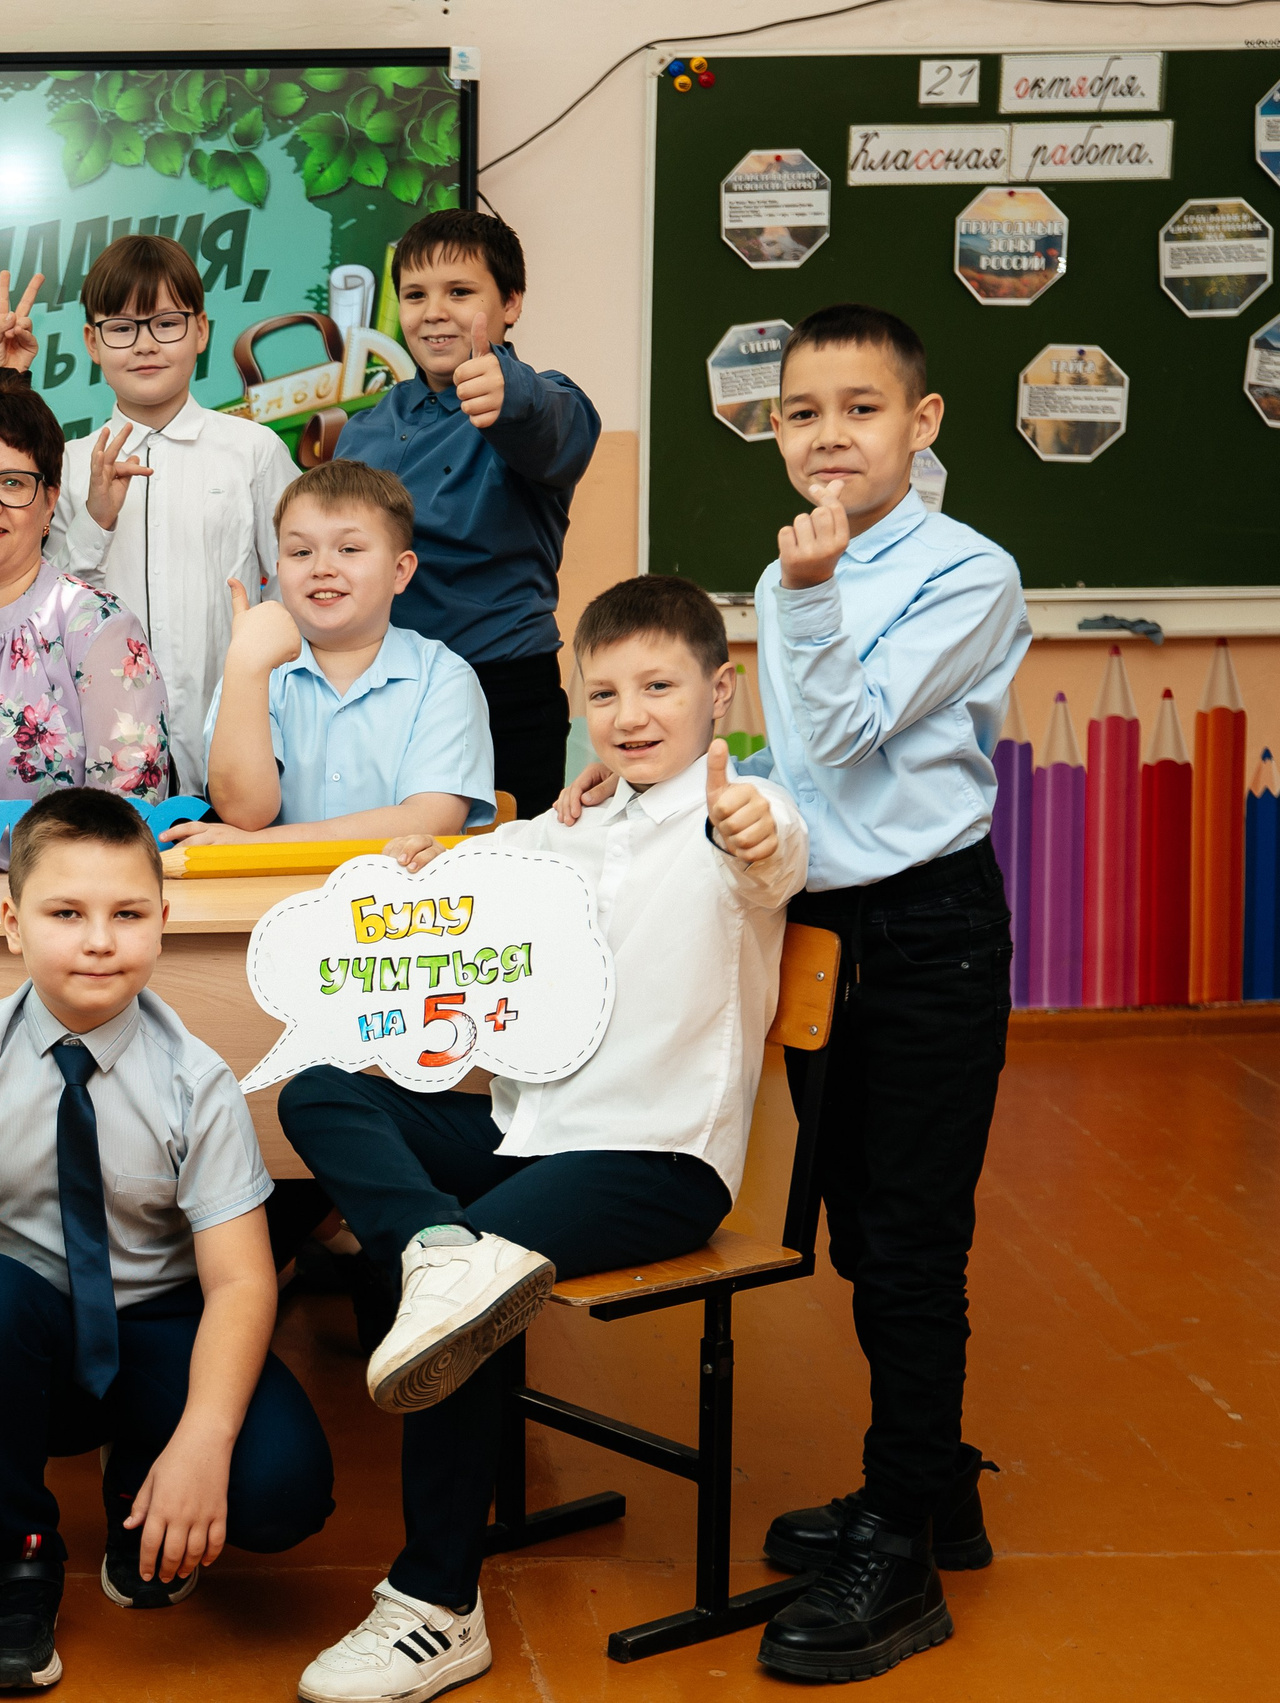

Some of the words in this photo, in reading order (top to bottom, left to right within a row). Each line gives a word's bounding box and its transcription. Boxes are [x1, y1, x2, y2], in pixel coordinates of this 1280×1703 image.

[925, 64, 978, 97] 21
[850, 131, 1007, 171] Классная
[960, 220, 1063, 236] ПРИРОДНЫЕ
[988, 237, 1036, 253] ЗОНЫ
[979, 255, 1046, 271] РОССИИ
[319, 942, 533, 995] УЧИТЬСЯ
[357, 1009, 407, 1043] НА
